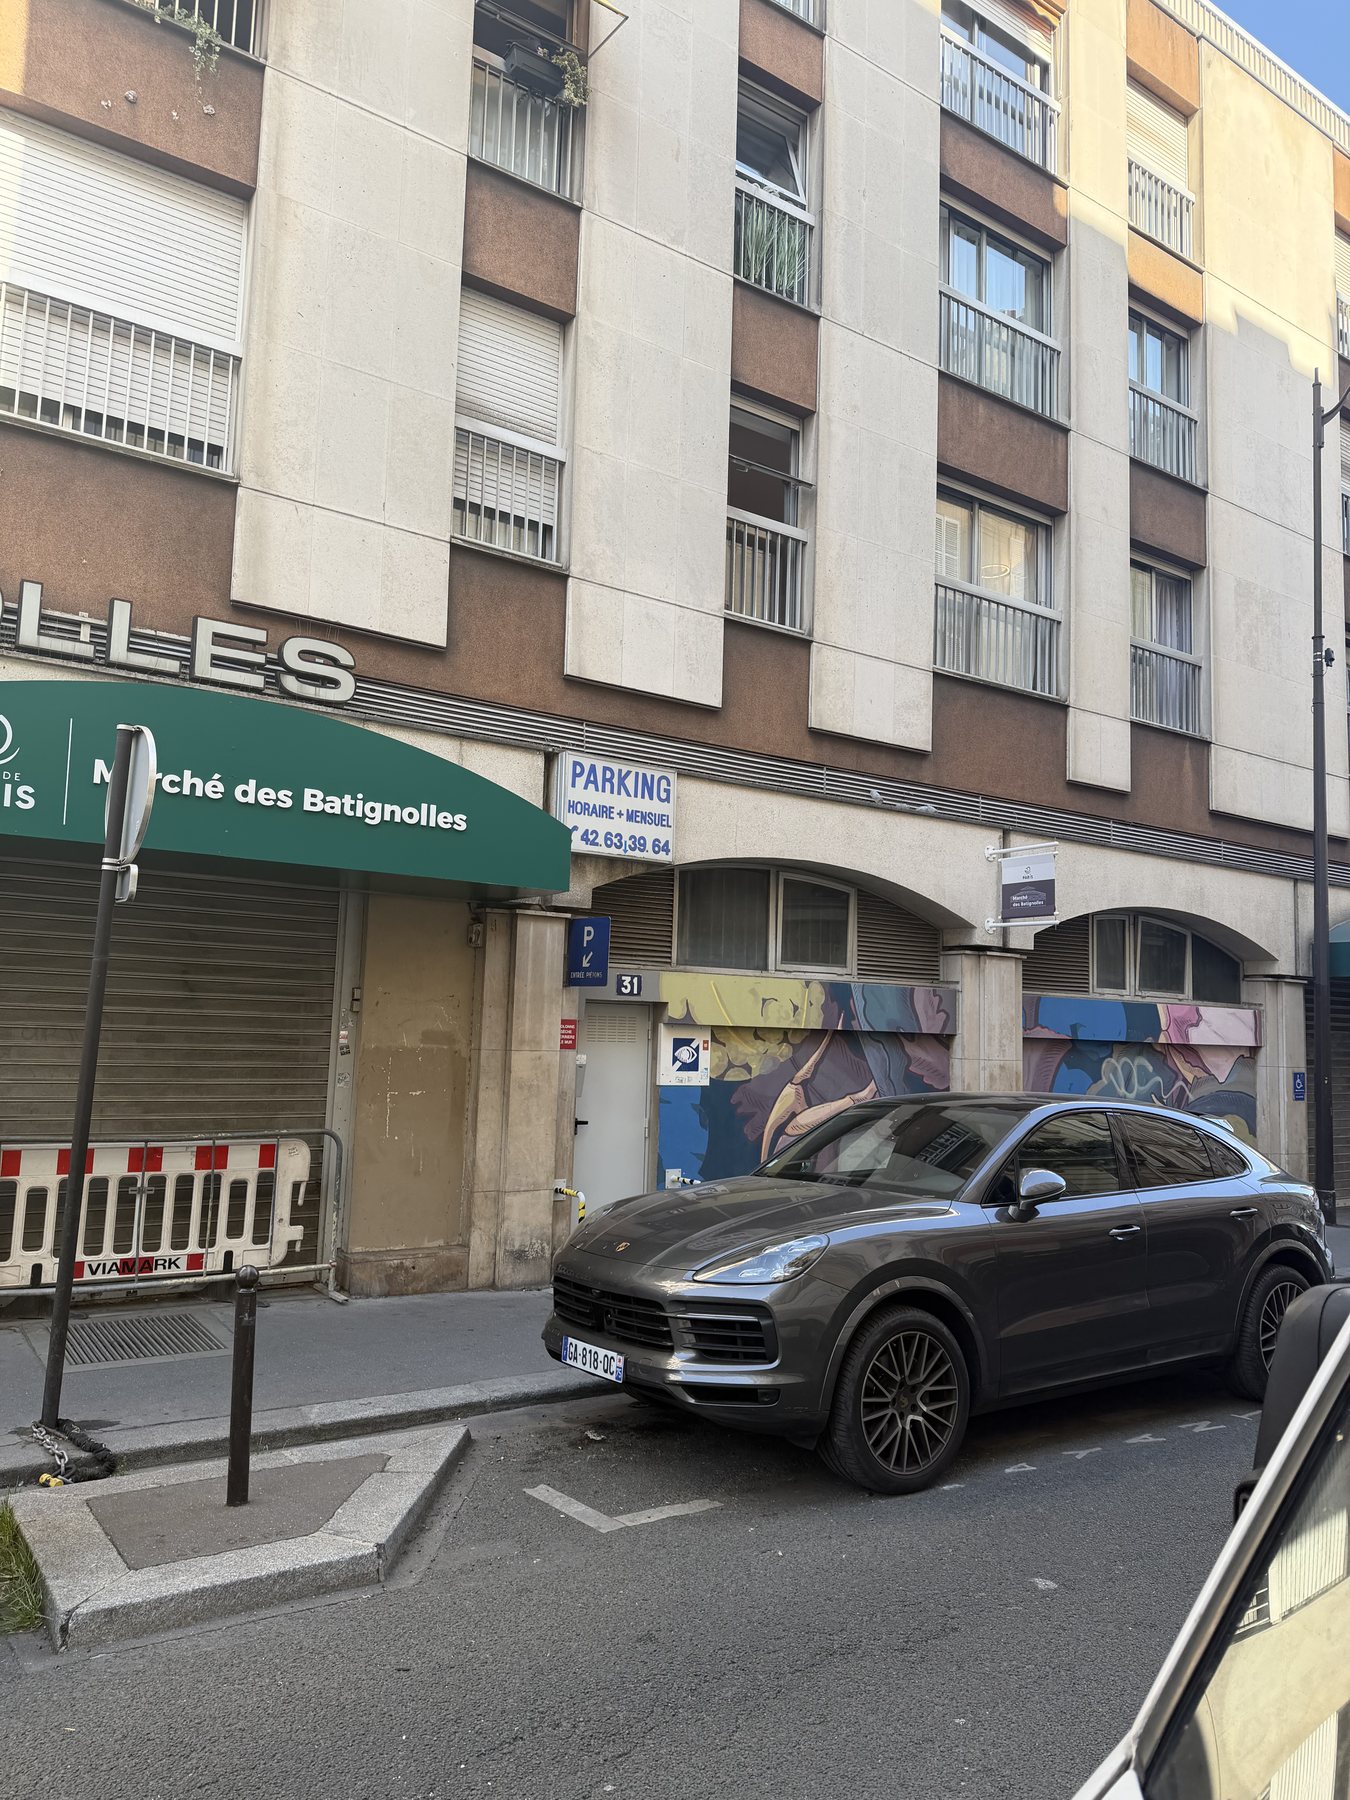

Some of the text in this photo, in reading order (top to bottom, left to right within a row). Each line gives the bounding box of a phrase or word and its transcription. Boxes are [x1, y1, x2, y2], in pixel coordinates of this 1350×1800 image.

[0, 578, 358, 706] LLES
[3, 783, 36, 810] IS
[570, 760, 671, 804] PARKING
[233, 778, 294, 808] des
[302, 787, 468, 832] Batignolles
[567, 799, 615, 820] HORAIRE
[625, 808, 672, 828] MENSUEL
[583, 926, 595, 947] P
[621, 975, 638, 995] 31
[87, 1257, 181, 1276] VIAMARK
[568, 1341, 616, 1376] GA-818-QC
